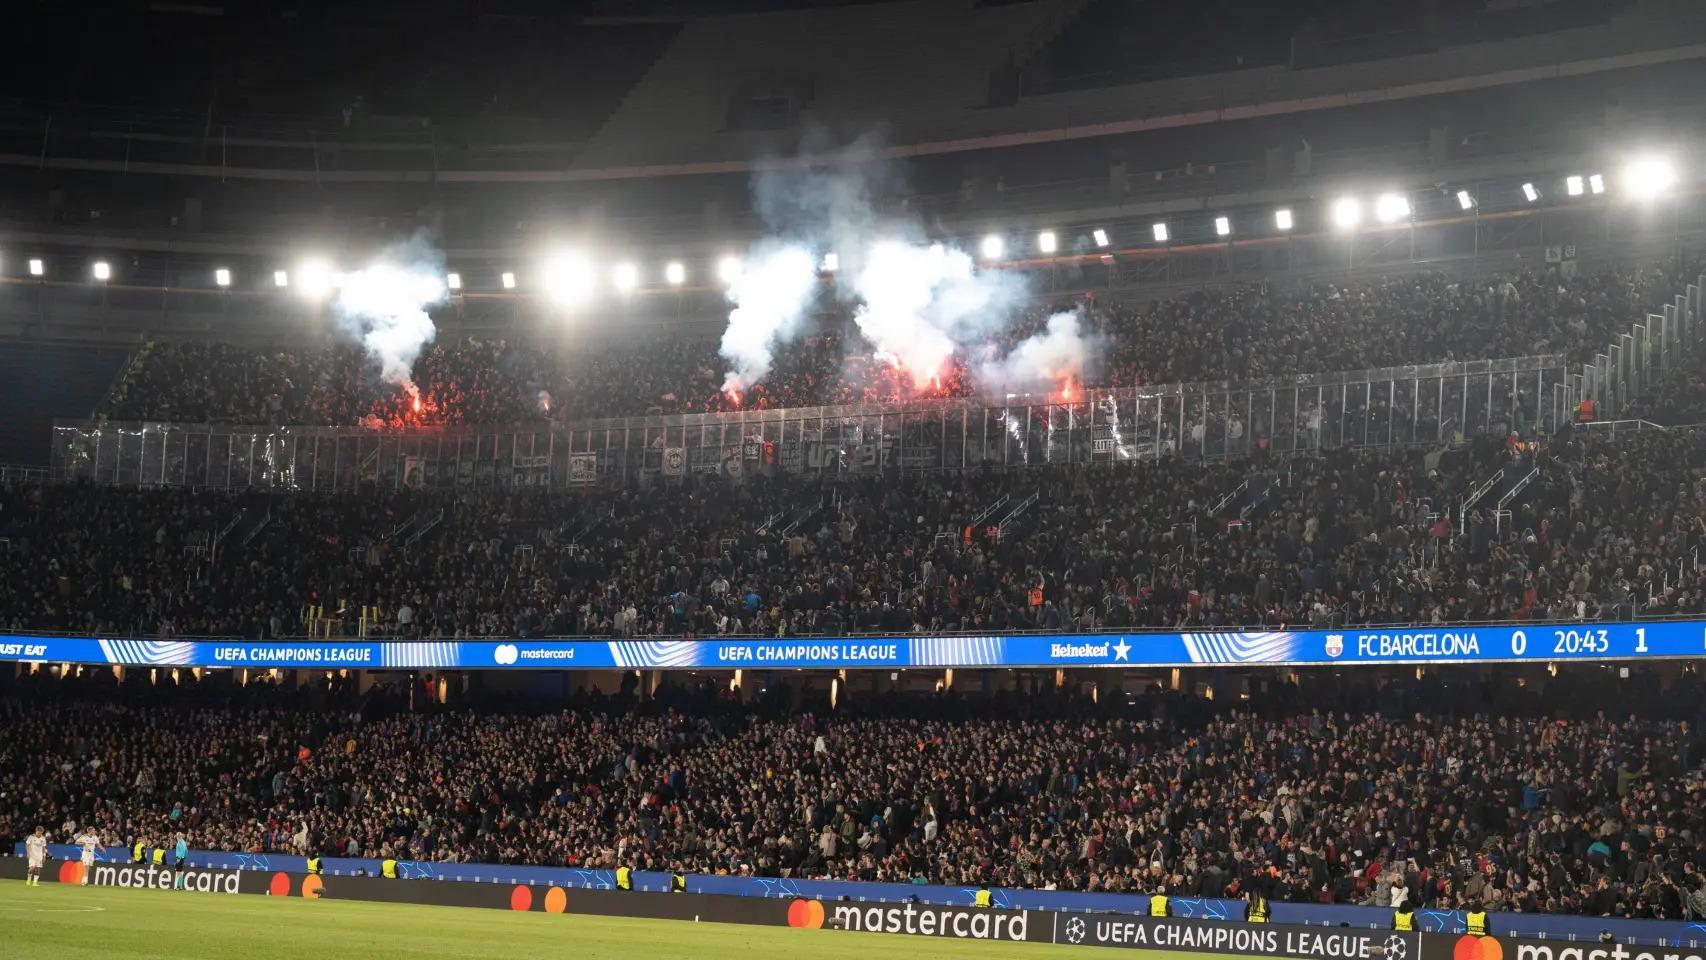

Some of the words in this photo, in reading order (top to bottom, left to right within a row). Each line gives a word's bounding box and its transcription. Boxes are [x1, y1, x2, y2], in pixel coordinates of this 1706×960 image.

[24, 644, 48, 657] EAT
[1050, 642, 1109, 659] Heineken
[1357, 634, 1378, 656] FC
[1379, 632, 1480, 656] BARCELONA
[1511, 630, 1526, 655] 0
[1553, 629, 1609, 653] 20:43
[1634, 627, 1649, 653] 1
[214, 648, 247, 661] UEFA
[250, 648, 321, 662] CHAMPIONS
[323, 648, 371, 662] LEAGUE
[520, 647, 574, 660] mastercard
[717, 646, 753, 661] UEFA
[756, 645, 839, 662] CHAMPIONS
[843, 644, 897, 661] LEAGUE
[834, 903, 1028, 941] mastercard
[1096, 921, 1147, 944] UEFA
[1153, 924, 1278, 953] CHAMPIONS
[1286, 932, 1371, 959] LEAGUE
